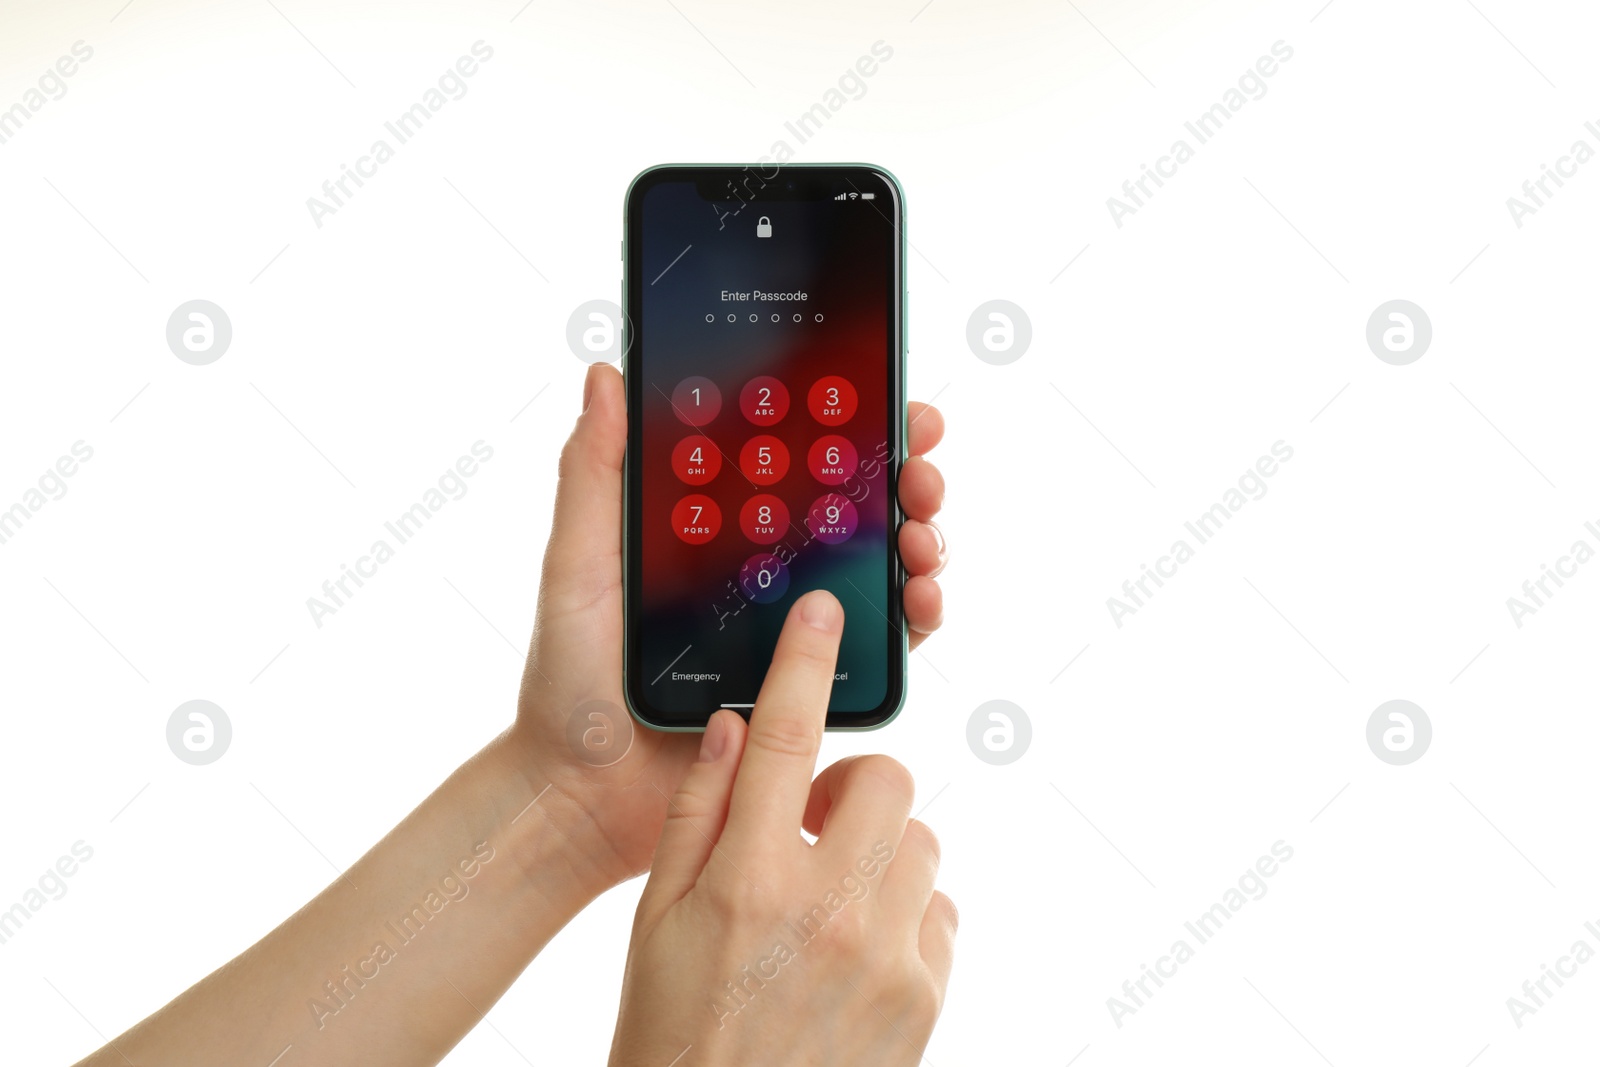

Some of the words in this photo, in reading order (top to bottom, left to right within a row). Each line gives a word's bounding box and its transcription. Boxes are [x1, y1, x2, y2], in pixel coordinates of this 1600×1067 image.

[721, 290, 751, 302] Enter
[753, 290, 808, 302] Passcode
[691, 387, 700, 406] 1
[758, 387, 771, 406] 2
[826, 387, 839, 406] 3
[689, 447, 704, 465] 4
[758, 447, 771, 466] 5
[826, 447, 840, 466] 6
[690, 506, 703, 525] 7
[757, 506, 771, 525] 8
[826, 506, 840, 525] 9
[757, 569, 772, 589] 0
[672, 671, 721, 682] Emergency
